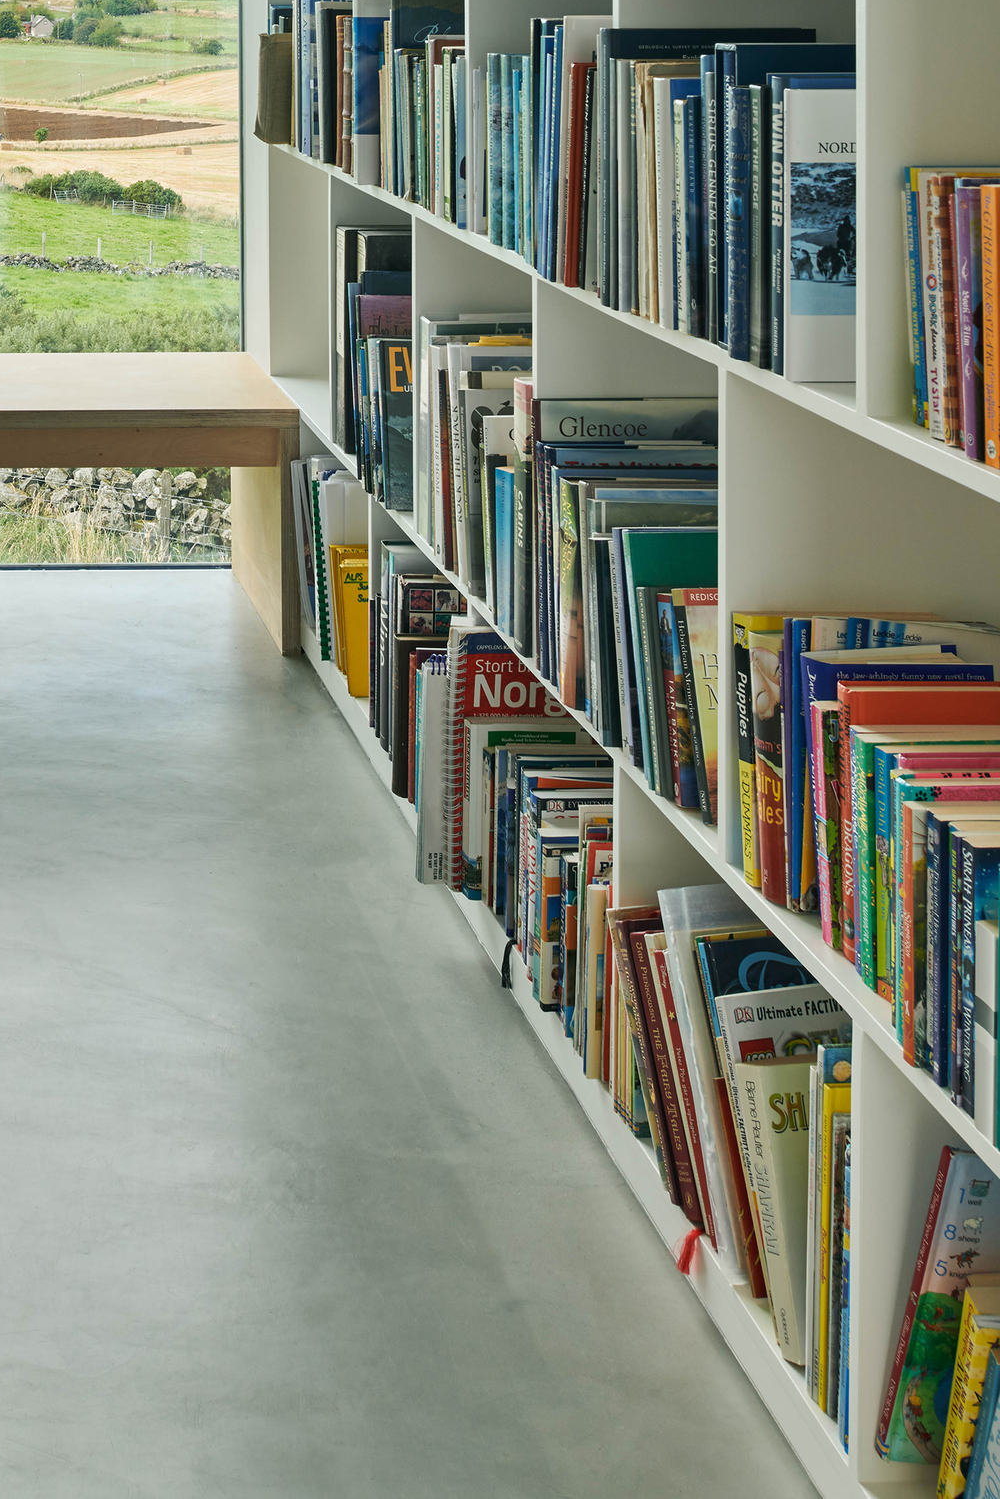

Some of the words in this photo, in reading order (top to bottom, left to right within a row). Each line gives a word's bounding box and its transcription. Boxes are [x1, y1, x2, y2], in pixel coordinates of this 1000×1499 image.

[708, 98, 716, 152] SIRIUS
[752, 127, 759, 145] AT
[771, 100, 784, 154] TWIN
[752, 147, 760, 172] THE
[708, 159, 717, 220] GENNEM
[752, 174, 760, 210] EDGE
[771, 161, 784, 228] OTTER
[904, 182, 912, 211] BRIAN
[983, 192, 991, 210] The
[906, 213, 915, 251] PATTEN
[982, 211, 993, 256] GIRL
[909, 258, 918, 309] GARGLING
[984, 268, 994, 303] INK
[911, 310, 919, 335] WITH
[928, 293, 938, 328] DORK
[913, 337, 921, 367] JELLY
[984, 313, 995, 371] STARS
[930, 367, 938, 386] TV
[452, 405, 460, 450] SHACK
[558, 415, 648, 438] Glencoe
[455, 485, 463, 523] ROCK
[515, 490, 524, 548] CABINS
[345, 571, 364, 582] ALPS
[379, 600, 389, 667] Wine
[873, 628, 896, 639] Leckie
[902, 632, 923, 643] Leckie
[475, 659, 514, 674] Stort
[677, 620, 688, 670] Hebridean
[684, 671, 696, 720] Memories
[836, 671, 850, 680] the
[852, 671, 899, 681] jaw-achingly
[902, 672, 925, 681] funny
[945, 672, 964, 680] novel
[966, 672, 986, 680] from
[668, 679, 676, 711] IAIN
[736, 670, 748, 739] Puppies
[843, 703, 851, 737] TERRY
[670, 717, 679, 768] BANKS
[876, 757, 886, 796] Roald
[548, 800, 563, 811] DK
[741, 781, 752, 860] DUMMIES
[877, 800, 886, 833] Dahl
[528, 844, 536, 904] SPAIN
[819, 859, 828, 884] Lily
[843, 818, 854, 897] DRAGONS
[962, 847, 973, 895] SARAH
[820, 885, 829, 922] Alone
[860, 874, 868, 899] KATE
[860, 901, 869, 945] SAUNDERS
[963, 896, 973, 950] PRINEAS
[659, 964, 668, 989] Disney
[735, 1007, 754, 1023] DK
[756, 1005, 803, 1021] Ultimate
[635, 941, 644, 963] JAN
[651, 1027, 663, 1051] THE
[666, 1102, 683, 1151] TALES
[962, 1006, 972, 1083] WINTERLING
[679, 1067, 687, 1083] Plys
[683, 1096, 690, 1107] på
[720, 1025, 729, 1055] LEGENDS
[731, 1085, 741, 1117] Ultimate
[738, 1117, 750, 1152] FACTIVITY
[744, 1153, 754, 1188] Collection
[745, 1080, 757, 1119] Bjarne
[686, 1108, 697, 1144] opdagelse
[752, 1120, 764, 1160] Reuter
[934, 1170, 945, 1192] 1001
[959, 1187, 966, 1204] 1
[755, 1162, 780, 1257] SHAMRAN
[928, 1214, 934, 1223] to
[929, 1192, 940, 1215] Things
[921, 1239, 930, 1257] Long
[924, 1222, 933, 1240] Spot
[944, 1224, 957, 1241] 8
[957, 1235, 981, 1244] sheep
[916, 1257, 924, 1272] Ago
[934, 1259, 948, 1277] 5
[779, 1307, 790, 1346] Gyldendal
[902, 1314, 911, 1338] Gillian
[895, 1337, 906, 1367] Doherty
[883, 1378, 897, 1420] USBORNE
[950, 1357, 965, 1421] ANIMAL
